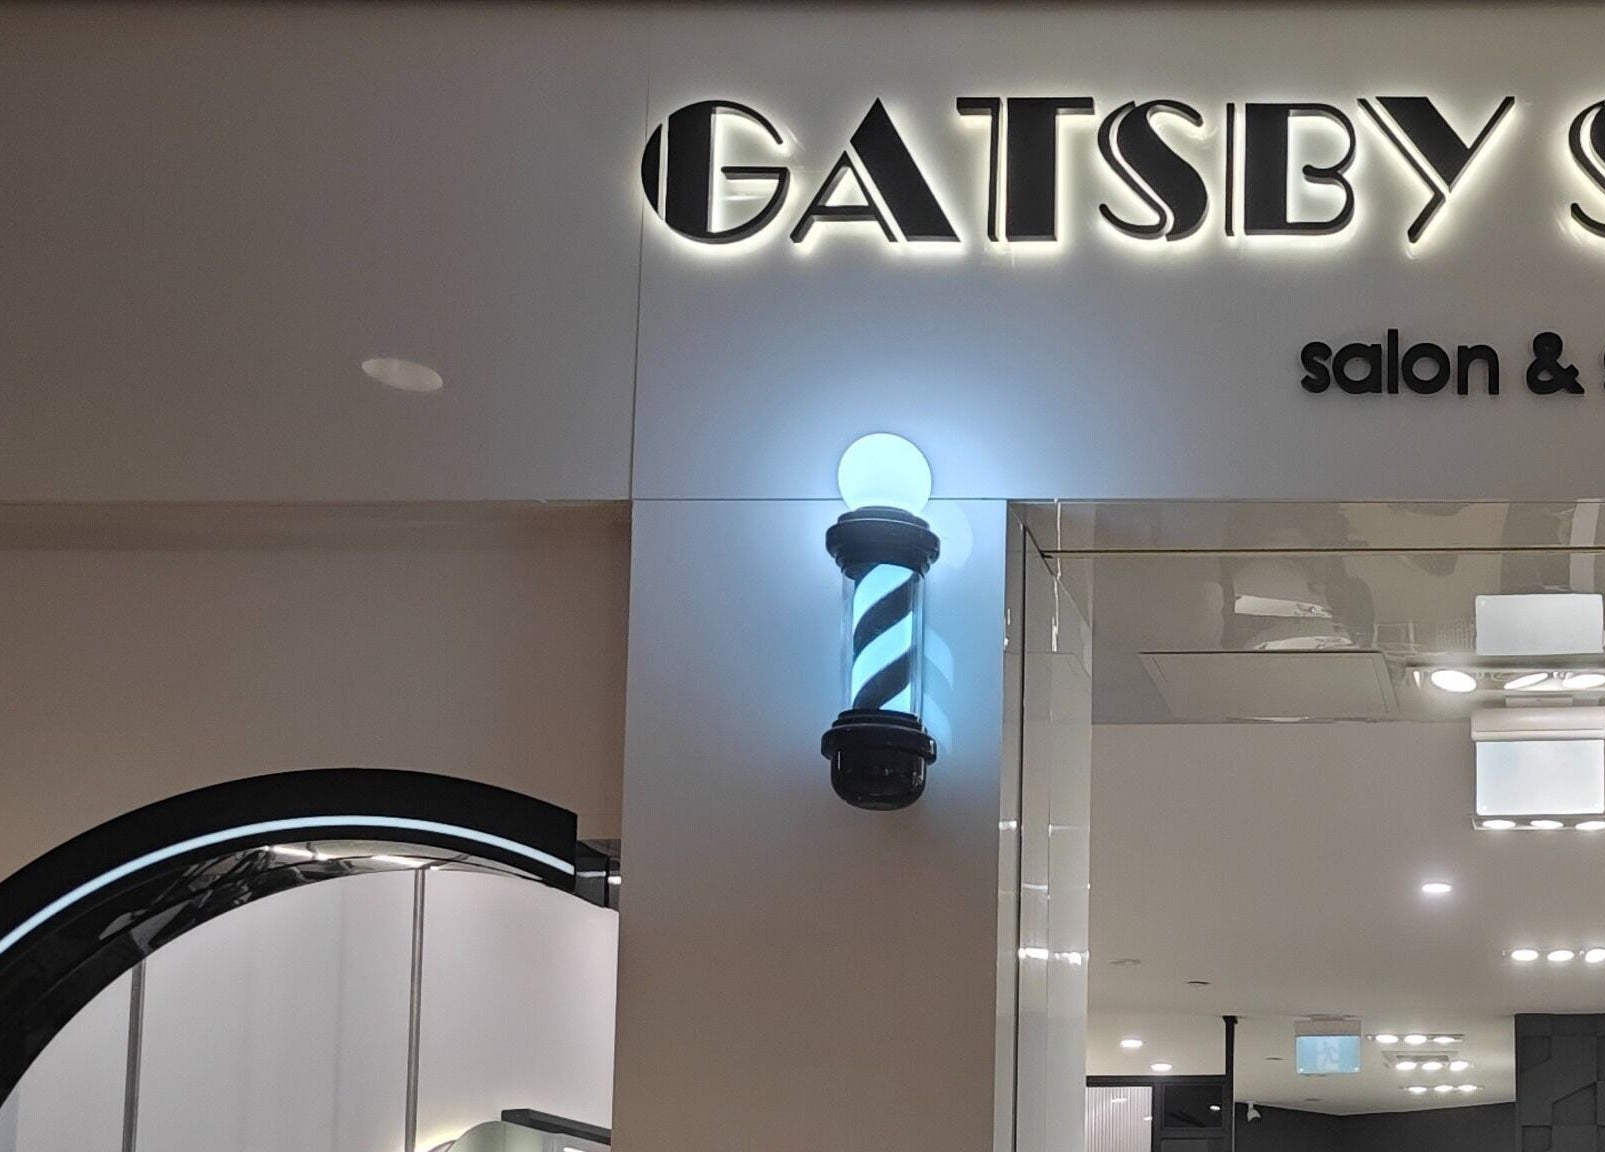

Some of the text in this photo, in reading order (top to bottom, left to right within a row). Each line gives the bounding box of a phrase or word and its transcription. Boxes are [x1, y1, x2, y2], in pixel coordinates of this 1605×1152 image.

[641, 96, 1515, 245] GATSBY
[1300, 329, 1500, 396] salon
[1526, 332, 1585, 396] &
